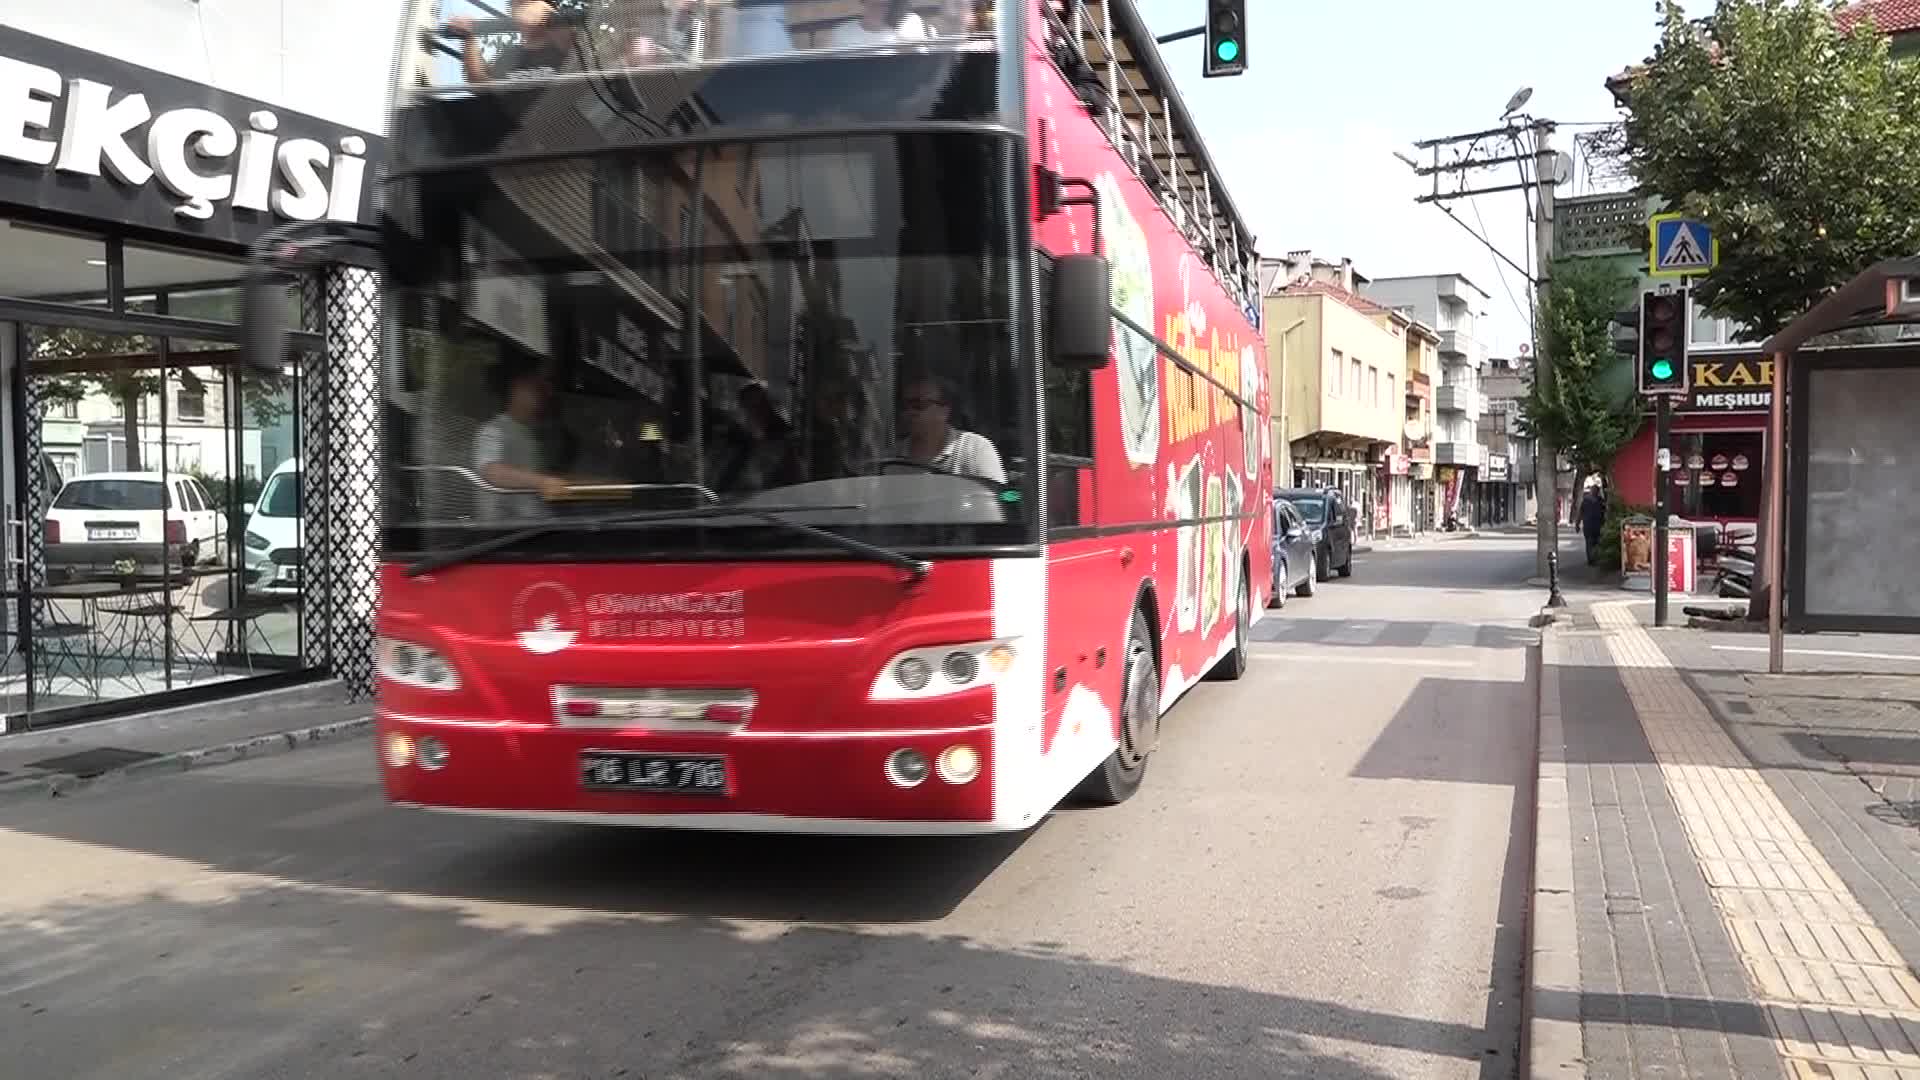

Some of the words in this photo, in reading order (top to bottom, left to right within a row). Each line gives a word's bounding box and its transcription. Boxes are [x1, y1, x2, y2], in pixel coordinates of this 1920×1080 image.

[585, 590, 744, 614] OSMANGAZİ
[588, 618, 744, 637] BELEDİYESİ
[592, 758, 624, 782] 16
[674, 761, 724, 787] 716
